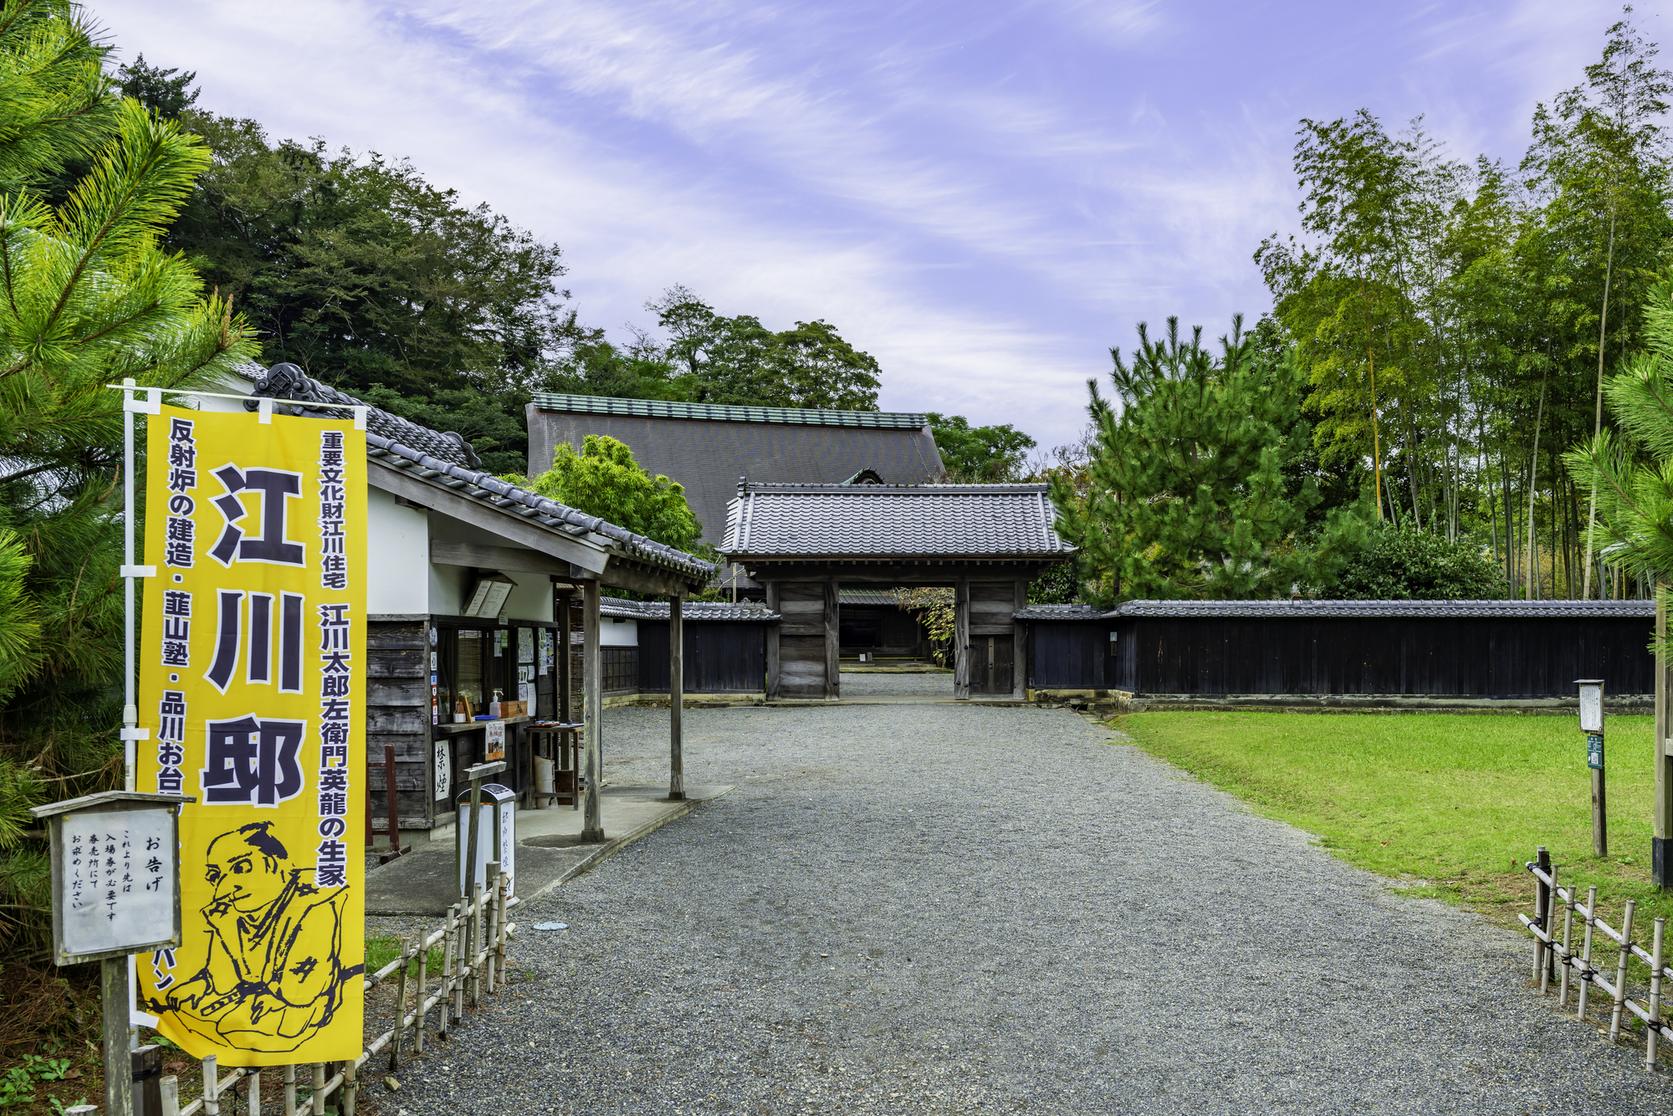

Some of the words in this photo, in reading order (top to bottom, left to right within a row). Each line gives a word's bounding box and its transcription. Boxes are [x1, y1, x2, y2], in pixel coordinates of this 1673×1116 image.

[318, 431, 347, 590] 重要文化財江川住宅
[157, 417, 197, 797] 反射炉の建造・韮山塾・品川お台
[201, 462, 308, 808] 江川邸
[317, 602, 351, 887] 江川太郎左衛門英龍の生家
[72, 835, 83, 908] お求めください
[88, 833, 99, 888] 券売所にて
[105, 833, 117, 921] 入場券が必要です
[122, 830, 133, 893] これより先は
[145, 836, 163, 892] お告げ
